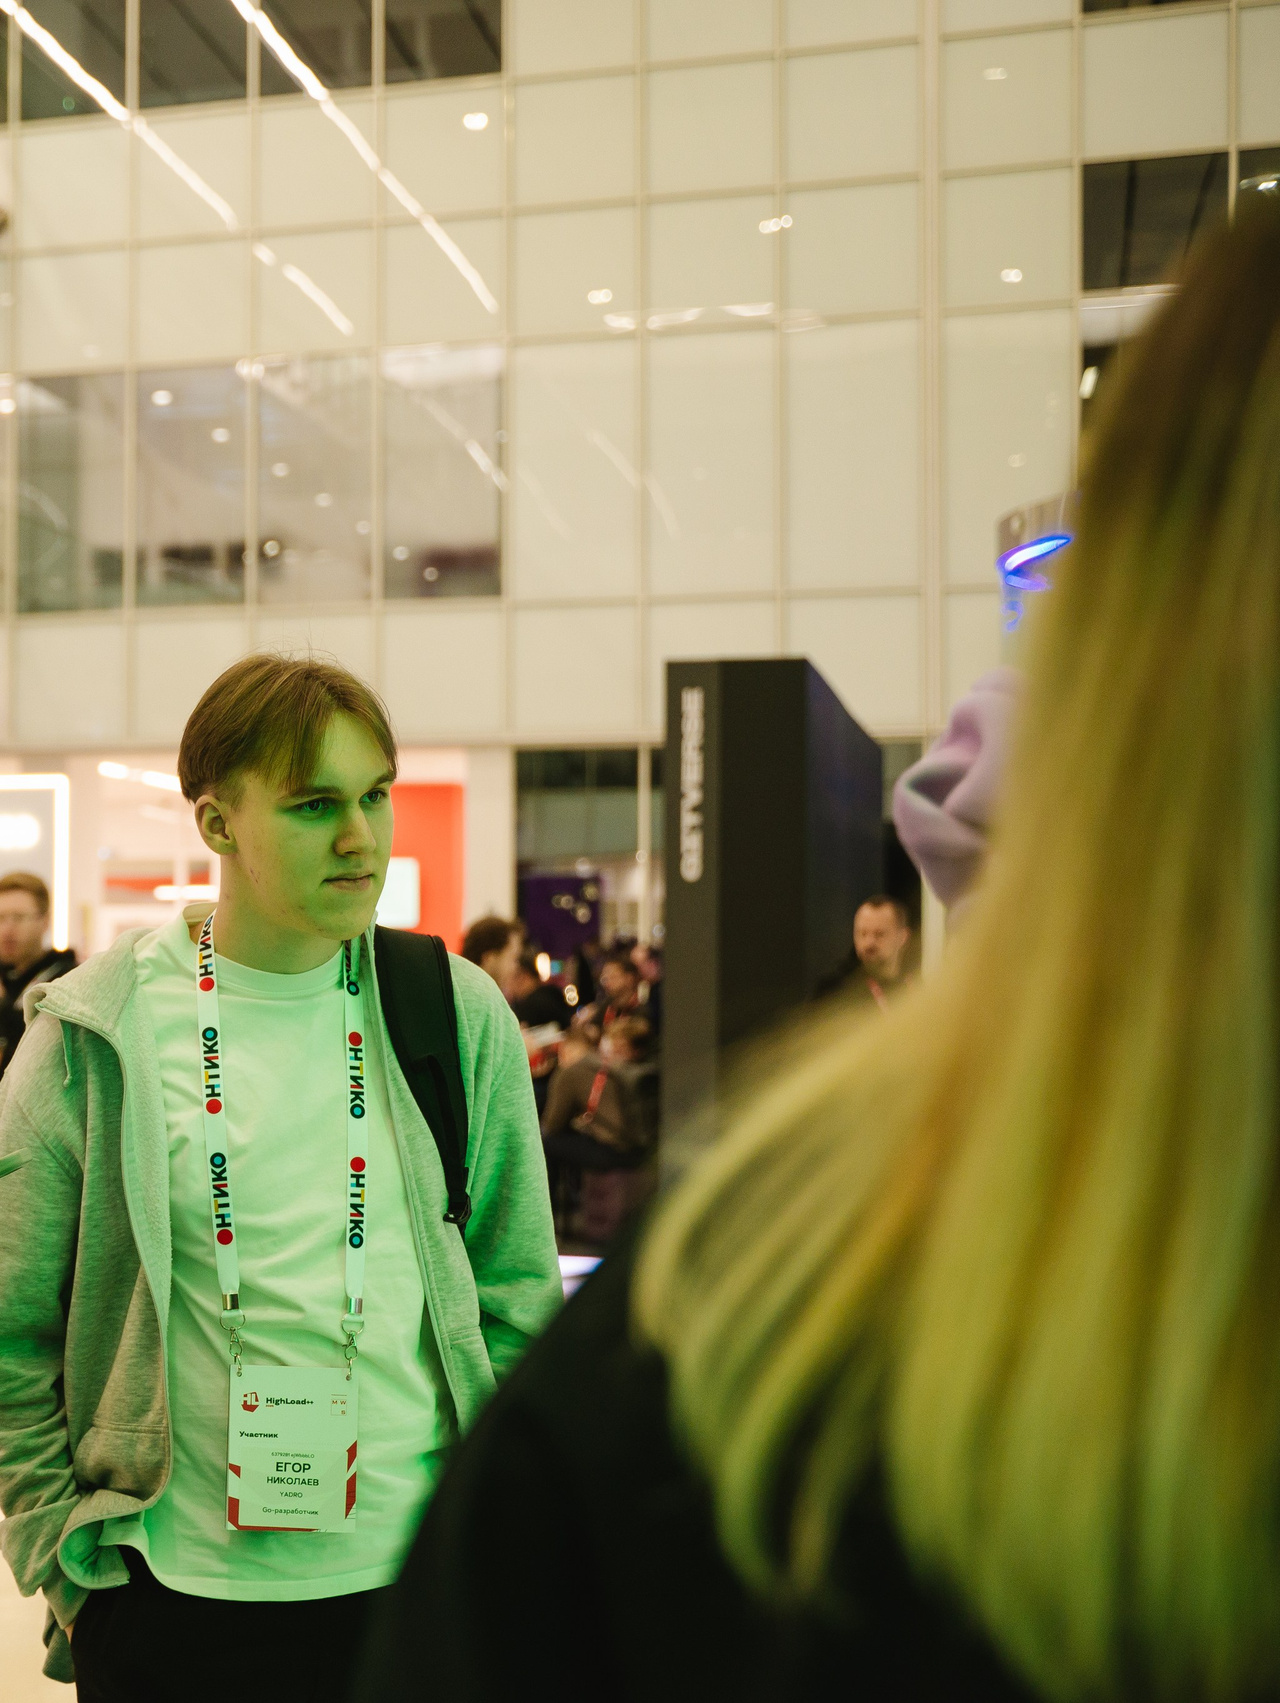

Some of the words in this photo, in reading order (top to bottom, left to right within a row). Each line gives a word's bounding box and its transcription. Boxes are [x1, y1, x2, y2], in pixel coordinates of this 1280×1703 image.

[265, 1397, 314, 1406] HighLoad++
[239, 1431, 278, 1439] Участник
[275, 1461, 311, 1473] ЕГОР
[266, 1476, 320, 1486] НИКОЛАЕВ
[262, 1507, 319, 1516] Go-разработчик
